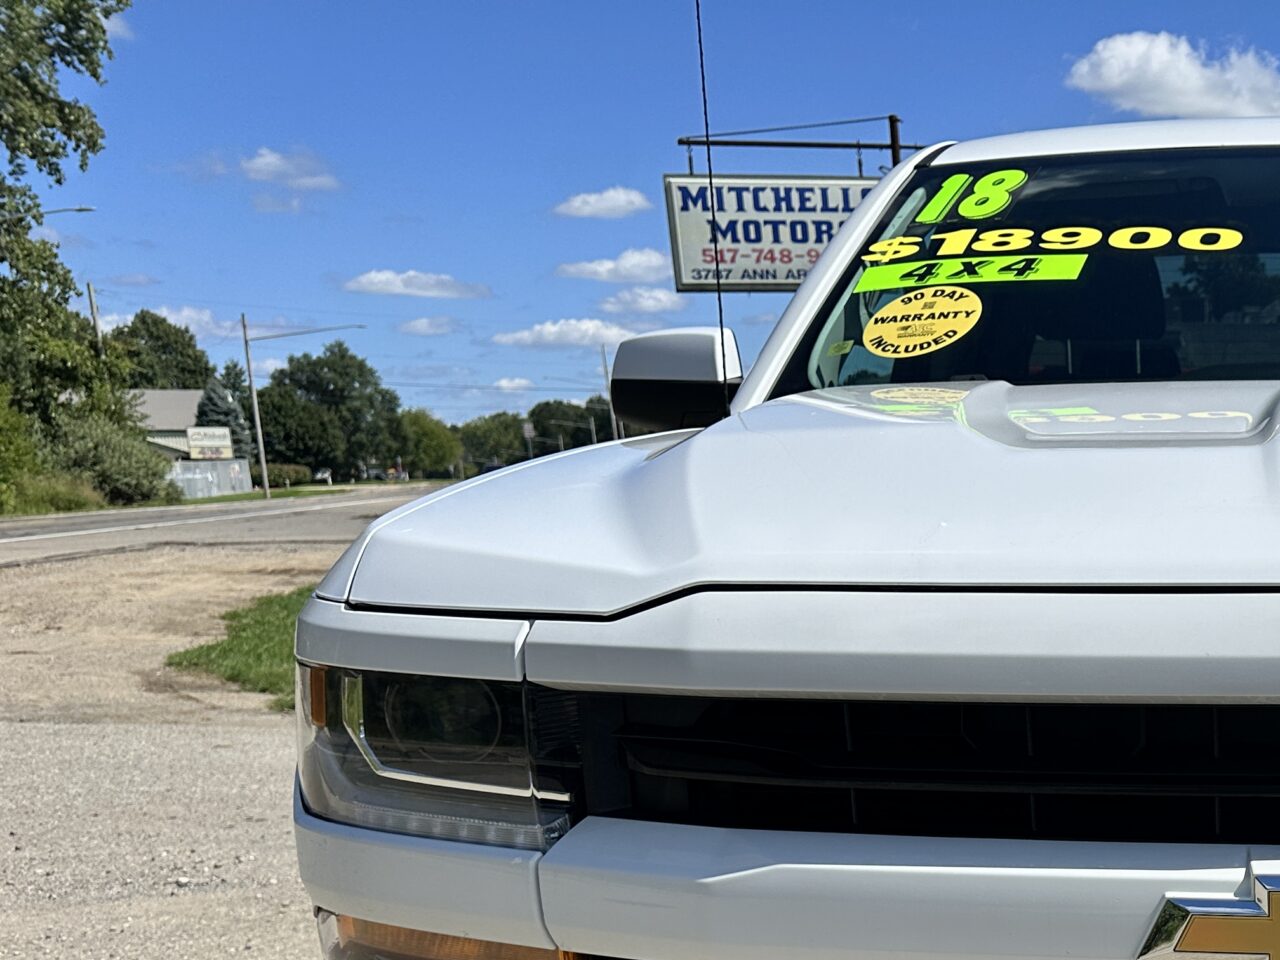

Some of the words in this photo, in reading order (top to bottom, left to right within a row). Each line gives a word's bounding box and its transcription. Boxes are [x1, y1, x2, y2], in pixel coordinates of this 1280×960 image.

[915, 169, 1028, 223] 18
[706, 219, 846, 244] MOTOR
[861, 226, 1243, 263] $18900
[741, 268, 777, 280] ANN
[900, 257, 1042, 284] 4X4
[900, 292, 925, 305] 90
[931, 289, 969, 301] DAY
[873, 310, 976, 325] WARRANTY
[869, 329, 958, 354] INCLUDED
